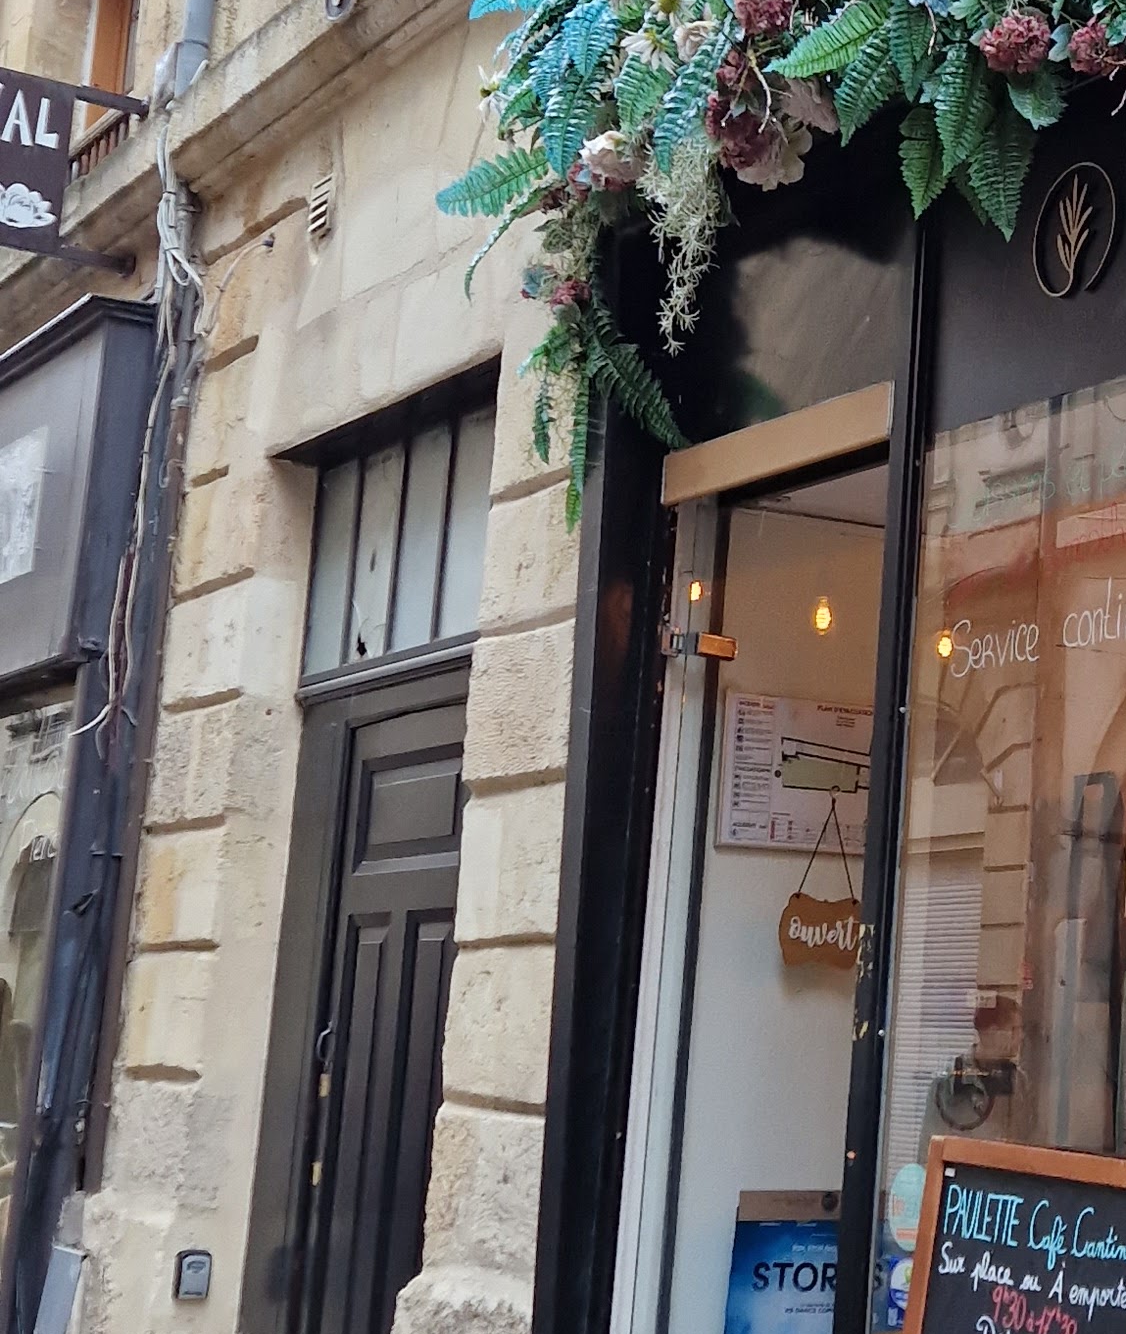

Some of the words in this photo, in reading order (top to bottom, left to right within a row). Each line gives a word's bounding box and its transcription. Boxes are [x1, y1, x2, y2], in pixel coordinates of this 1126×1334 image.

[943, 1183, 1025, 1247] PAULETTE
[1027, 1199, 1069, 1270] Café
[938, 1241, 966, 1276] Sur
[970, 1249, 1015, 1292] place
